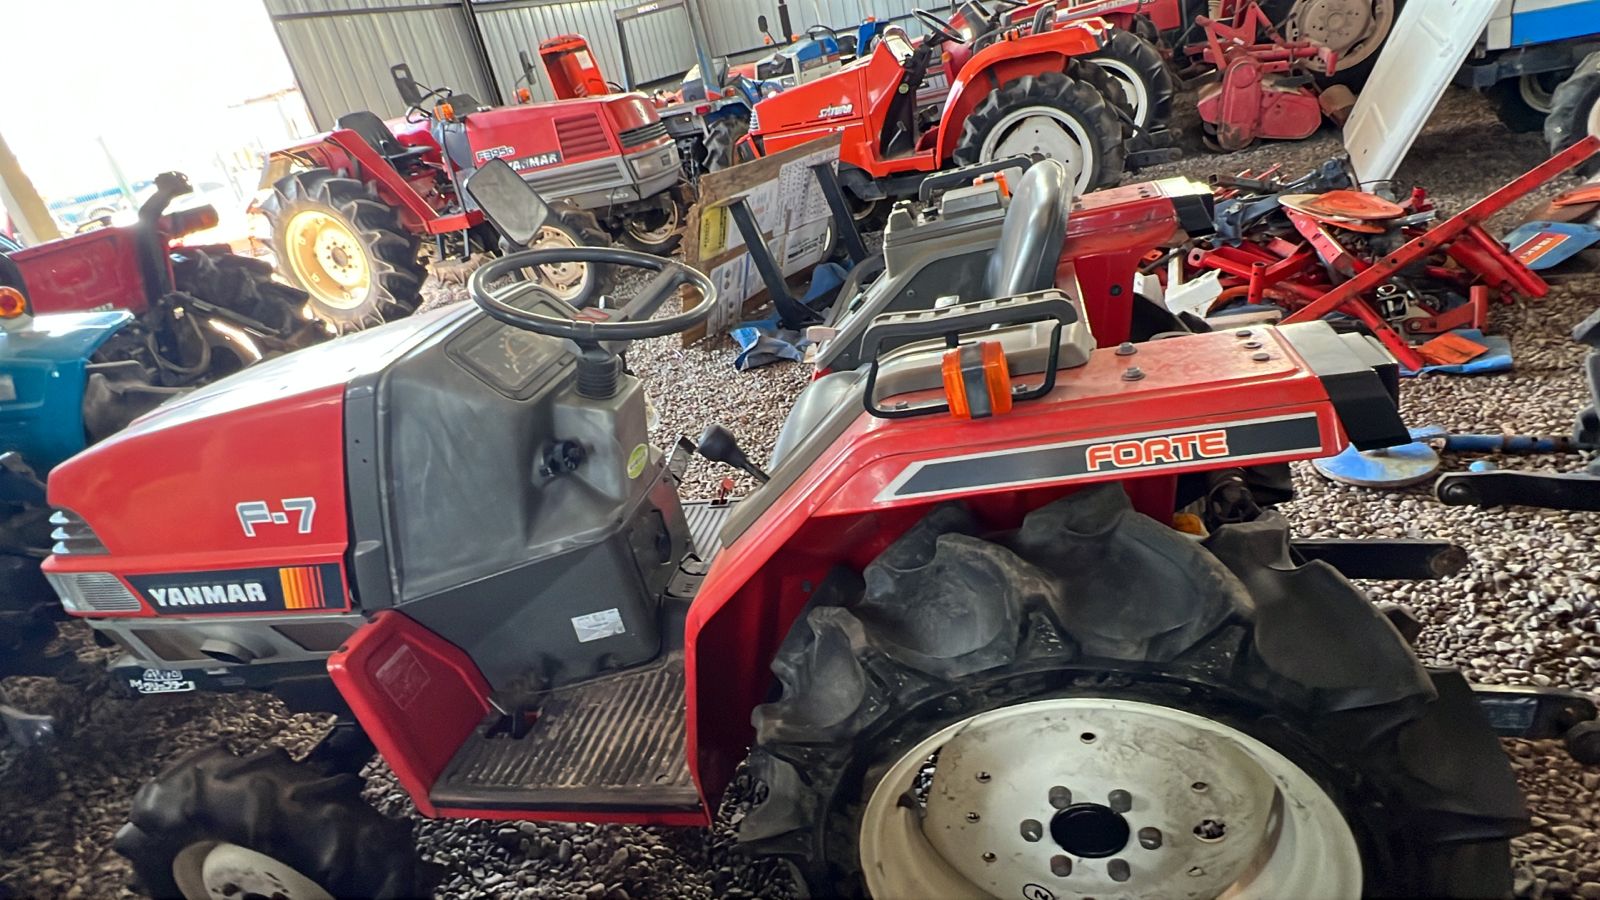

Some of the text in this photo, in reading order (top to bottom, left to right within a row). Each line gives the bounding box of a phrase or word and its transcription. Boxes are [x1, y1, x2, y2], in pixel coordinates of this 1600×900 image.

[1085, 429, 1230, 472] FORTE
[235, 496, 317, 537] F-7
[148, 582, 267, 607] YANMAR
